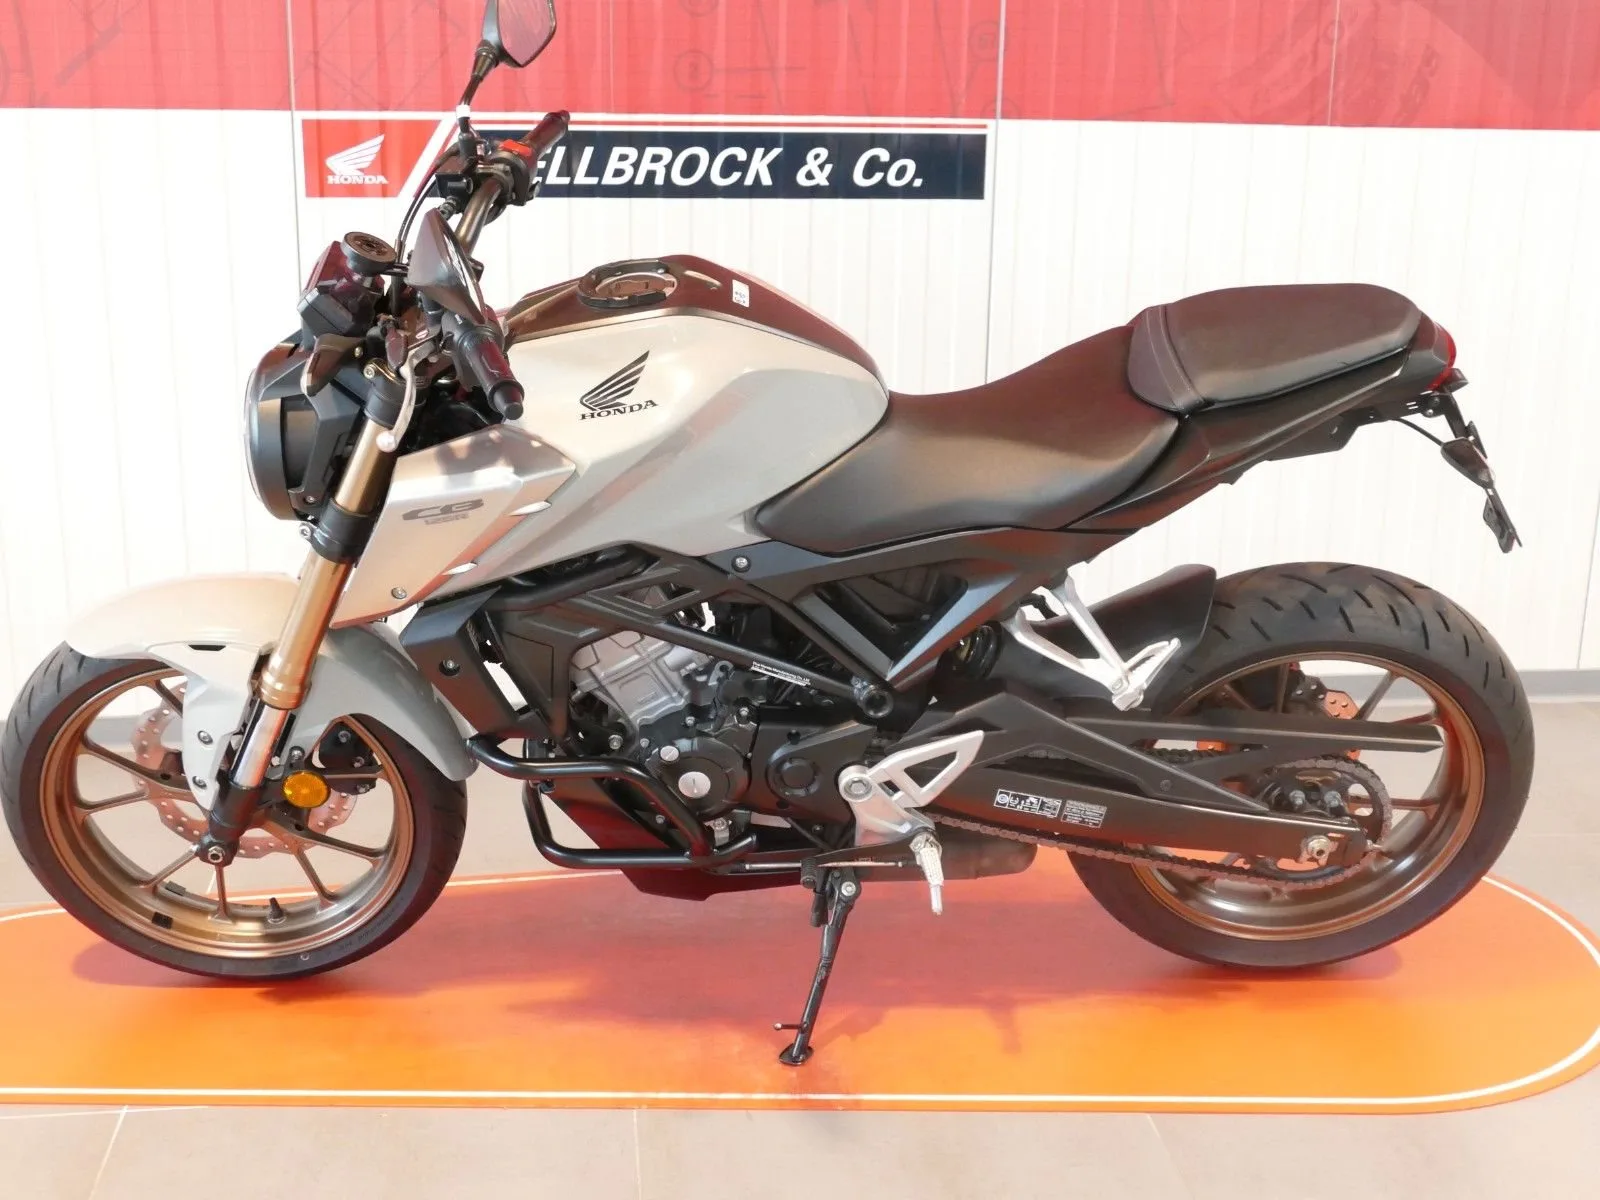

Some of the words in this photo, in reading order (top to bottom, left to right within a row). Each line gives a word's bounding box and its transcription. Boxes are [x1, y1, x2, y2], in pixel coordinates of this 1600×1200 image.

[796, 147, 833, 186] &
[853, 148, 923, 187] Co.
[327, 175, 388, 184] HONDA
[580, 400, 658, 420] HONDA
[402, 499, 484, 520] CB
